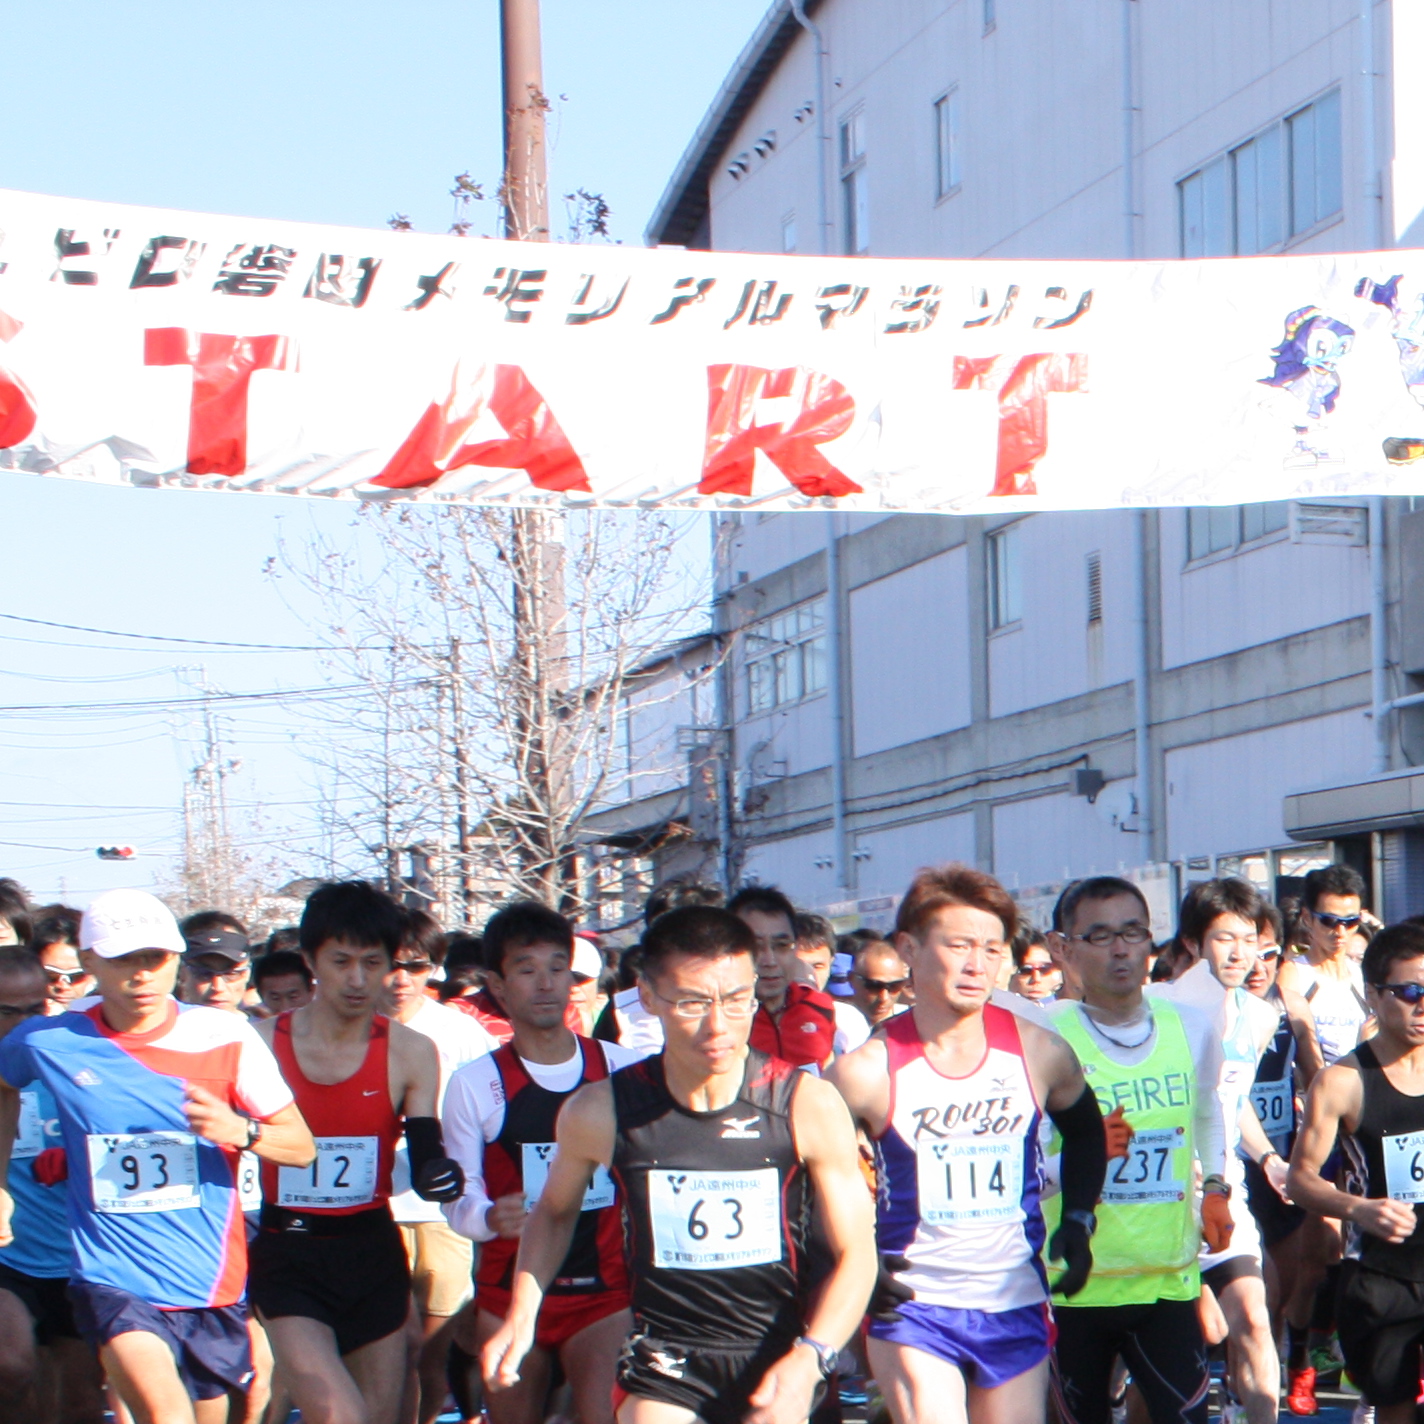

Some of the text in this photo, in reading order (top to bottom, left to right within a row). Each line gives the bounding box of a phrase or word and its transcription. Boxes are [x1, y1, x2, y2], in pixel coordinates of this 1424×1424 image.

[0, 226, 1096, 333] ビロ磐田メモリアルマラソン
[1092, 1072, 1192, 1117] SEIREI
[912, 1095, 1013, 1140] ROUTE
[972, 1113, 1024, 1136] 301
[120, 1153, 169, 1191] 93
[311, 1154, 351, 1189] 12
[945, 1159, 1006, 1201] 114
[1111, 1147, 1169, 1184] 237
[687, 1197, 744, 1241] 63
